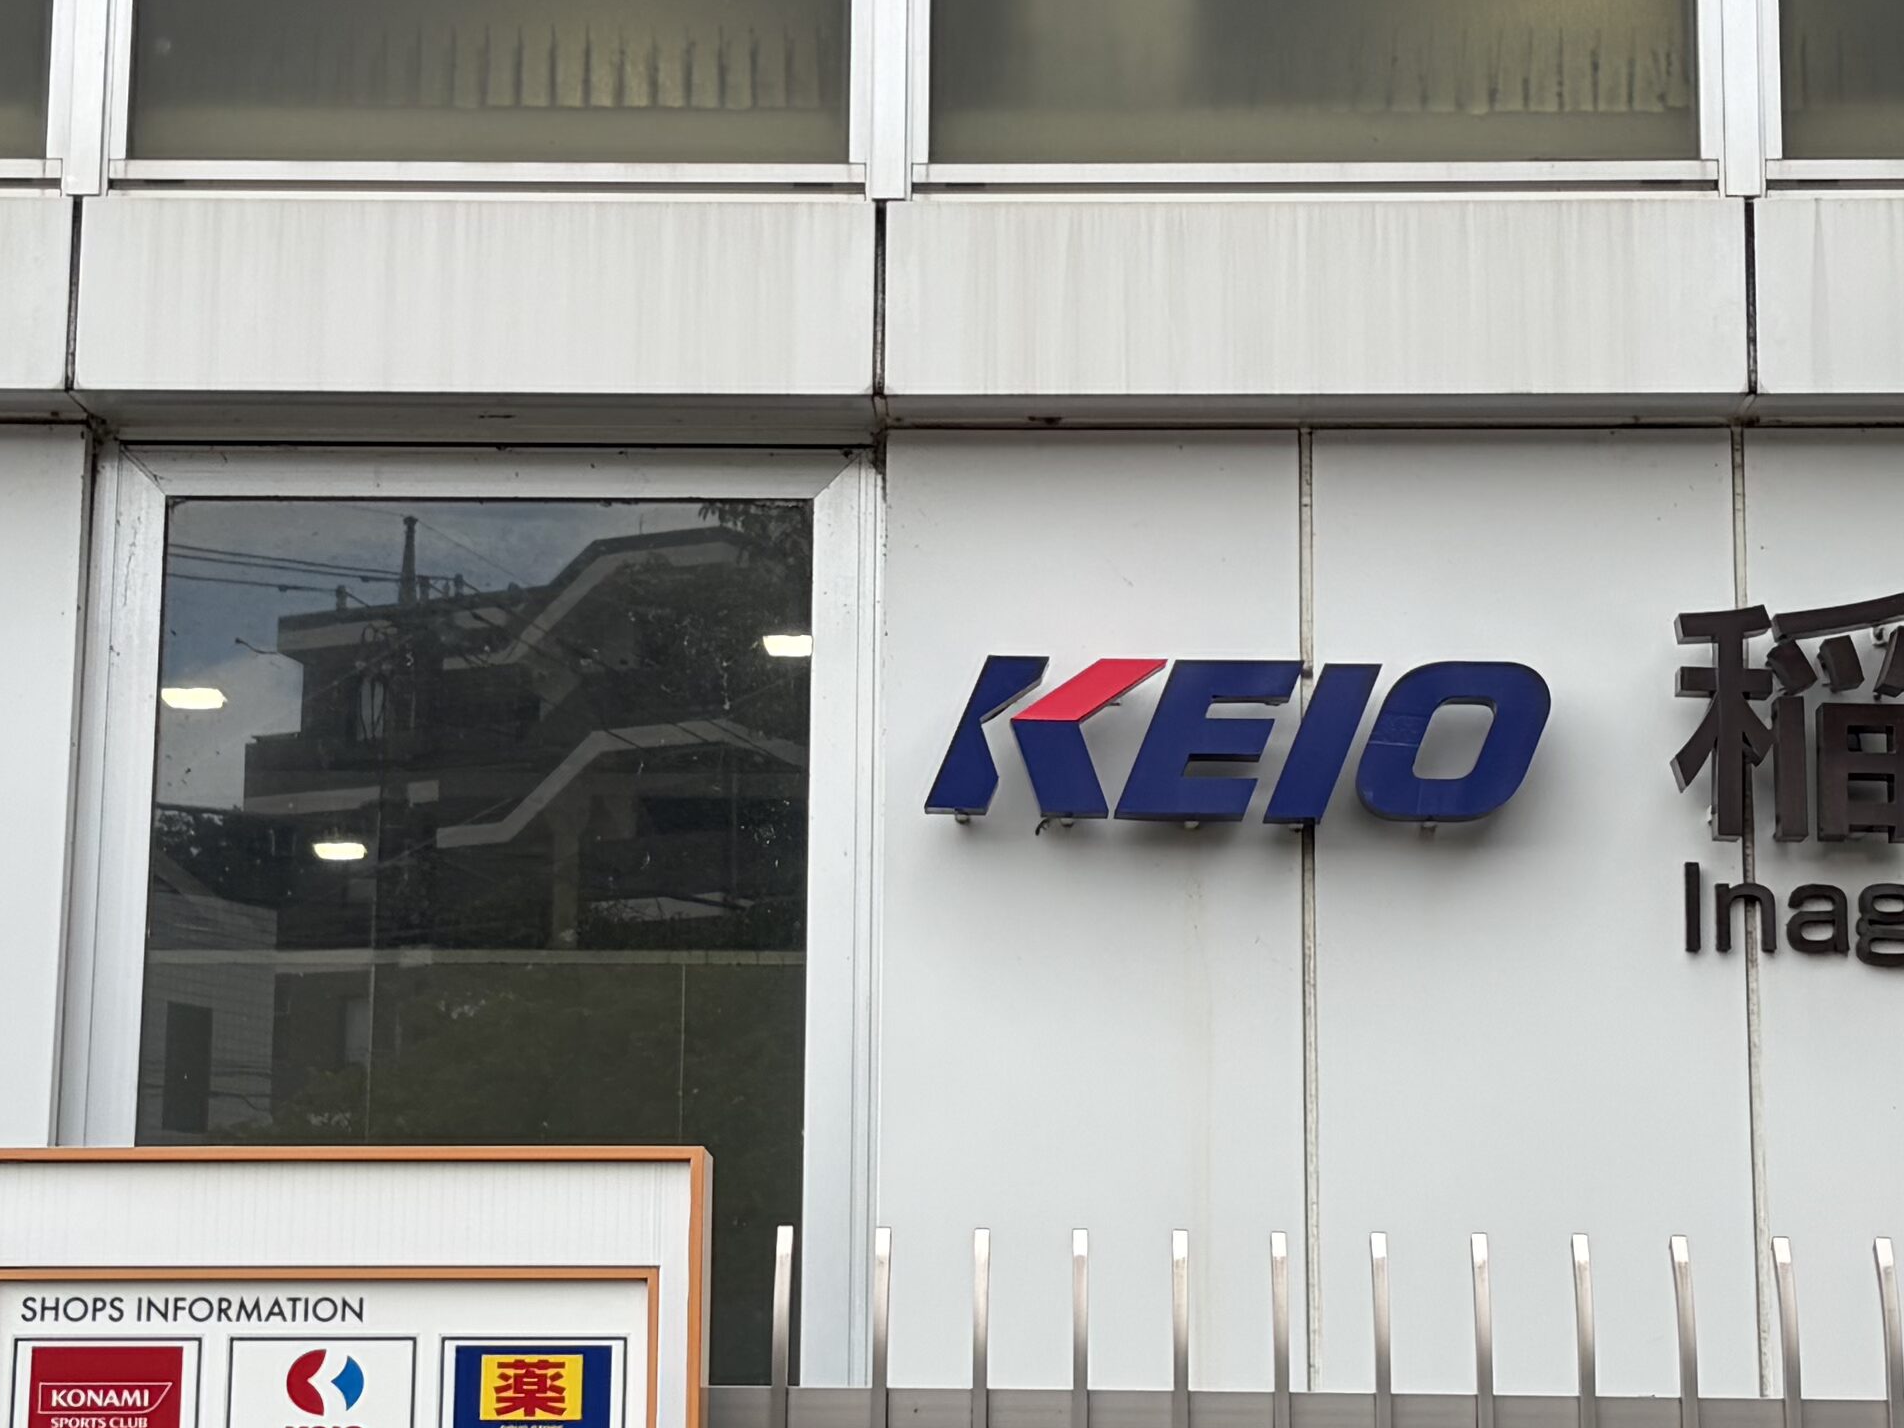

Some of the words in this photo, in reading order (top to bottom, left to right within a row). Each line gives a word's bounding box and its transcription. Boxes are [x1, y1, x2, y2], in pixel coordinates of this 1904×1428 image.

[925, 654, 1552, 822] KEIO
[21, 1296, 125, 1324] SHOPS
[136, 1297, 365, 1324] INFORMATION
[50, 1388, 150, 1408] KONAMI
[493, 1359, 566, 1417] 薬
[50, 1416, 107, 1428] SPORTS
[109, 1416, 149, 1428] CLUB
